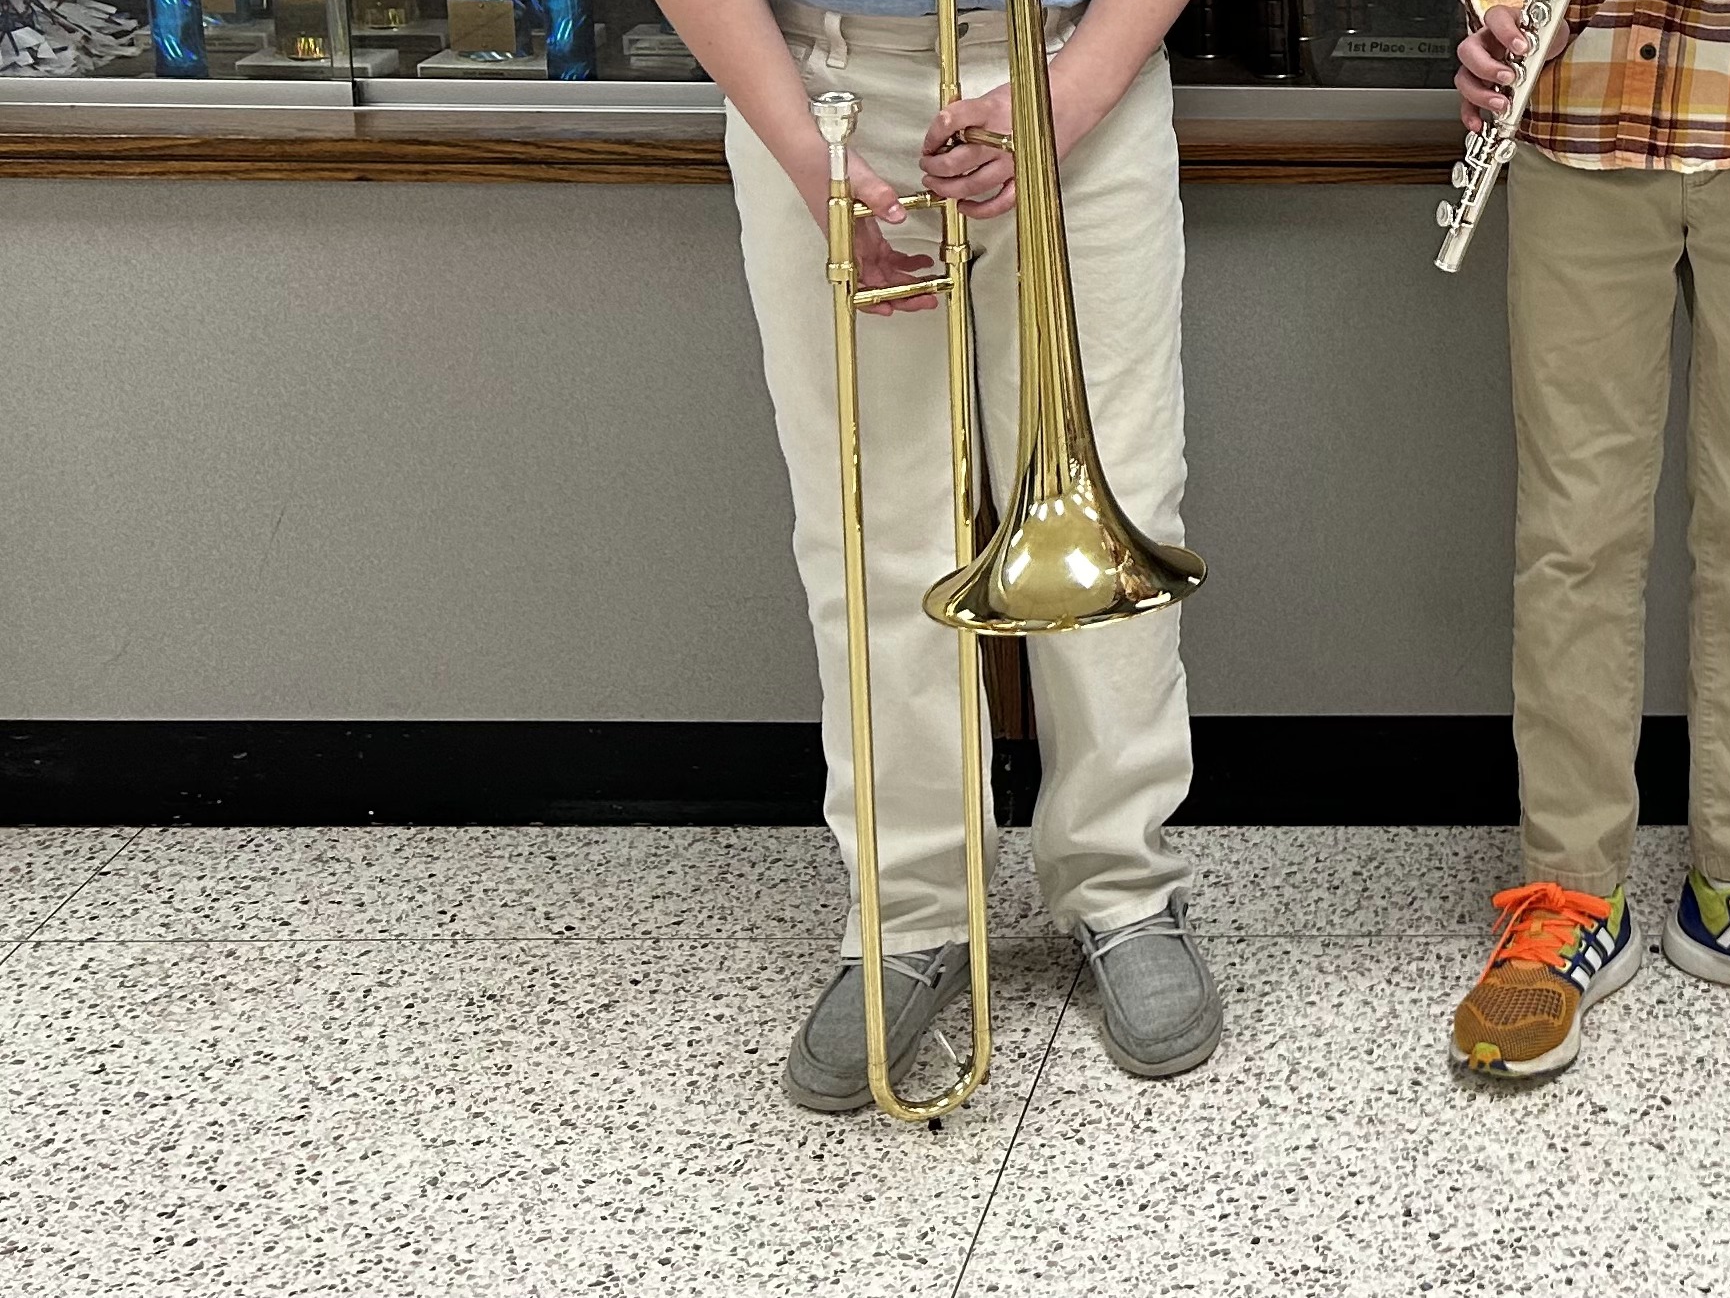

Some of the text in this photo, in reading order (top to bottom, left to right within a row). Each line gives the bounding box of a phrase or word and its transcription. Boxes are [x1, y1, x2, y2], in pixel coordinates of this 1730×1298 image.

[1347, 41, 1366, 52] 1st
[1370, 41, 1406, 53] Place
[1417, 42, 1449, 53] Clas
